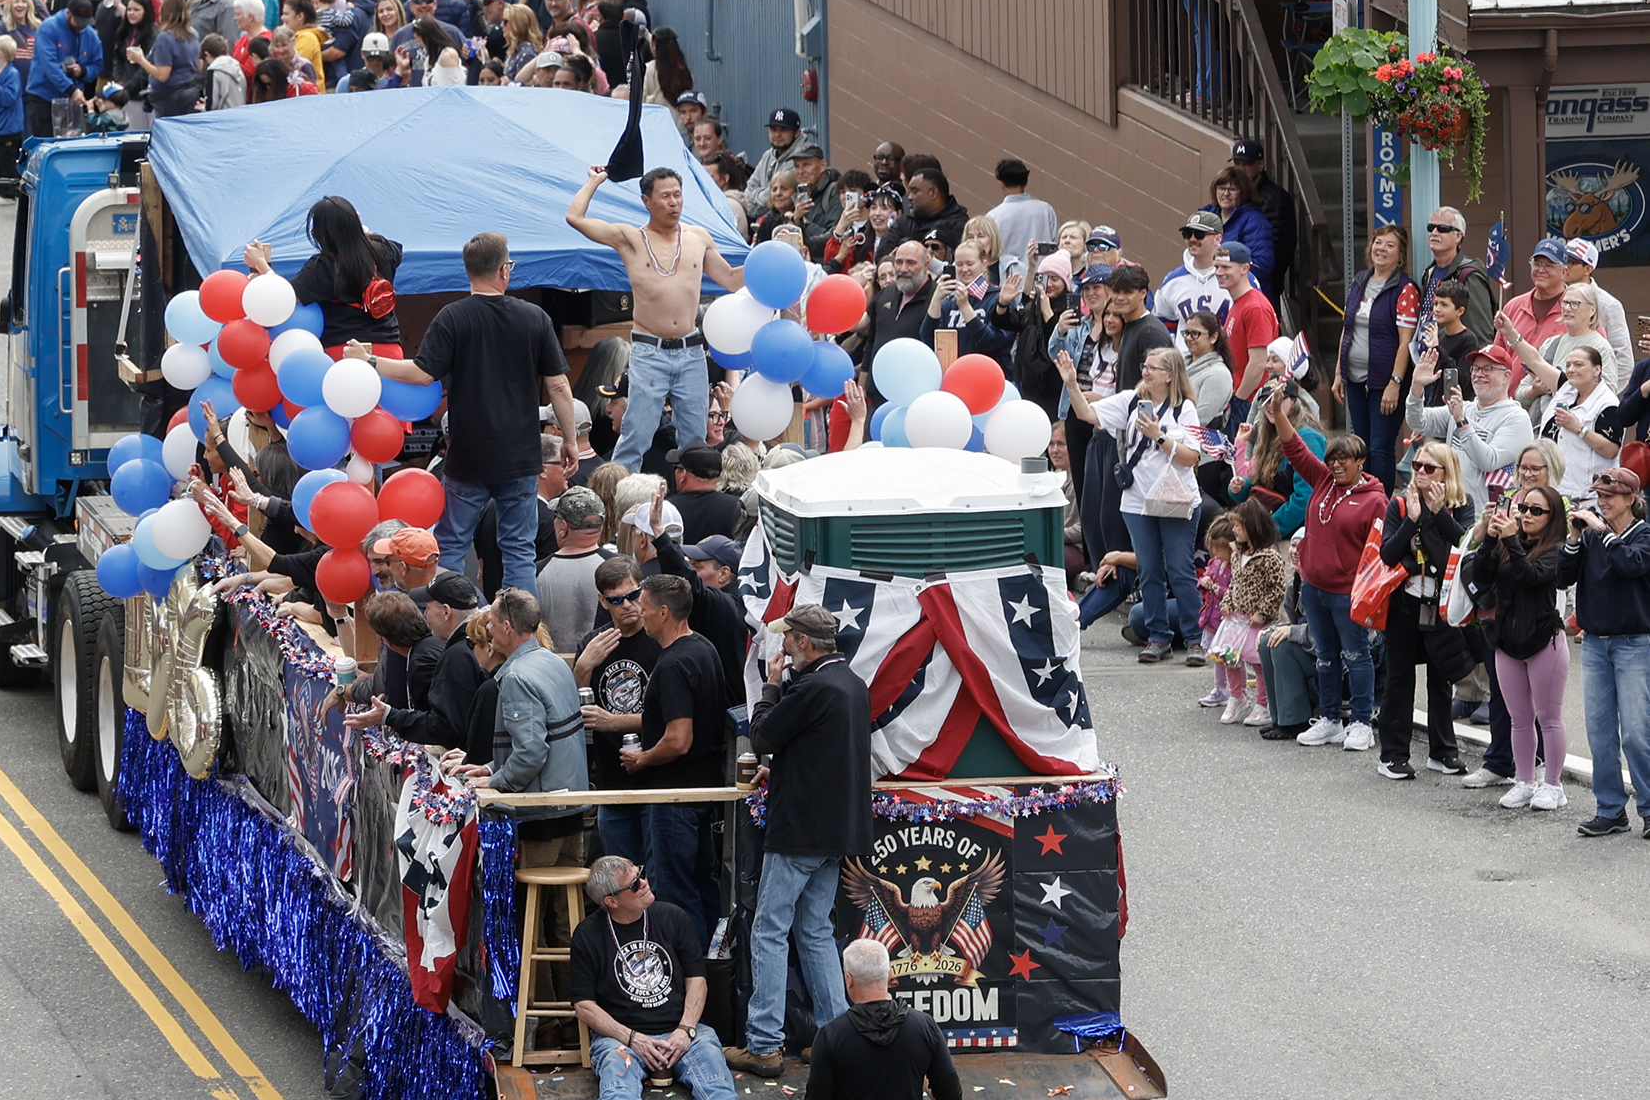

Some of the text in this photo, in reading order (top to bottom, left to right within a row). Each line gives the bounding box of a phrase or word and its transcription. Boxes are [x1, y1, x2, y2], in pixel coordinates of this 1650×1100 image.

[1546, 92, 1650, 133] ongass
[1547, 113, 1636, 124] TRADING COMPANY
[1236, 145, 1246, 154] M
[1379, 131, 1396, 209] ROOMS
[1178, 294, 1230, 326] USA
[625, 662, 642, 675] BLACK
[897, 826, 956, 848] YEARS
[956, 836, 982, 860] OF
[639, 942, 658, 952] BACK
[891, 960, 962, 975] 1776 2026
[627, 985, 635, 993] TO
[887, 987, 999, 1022] EDOM
